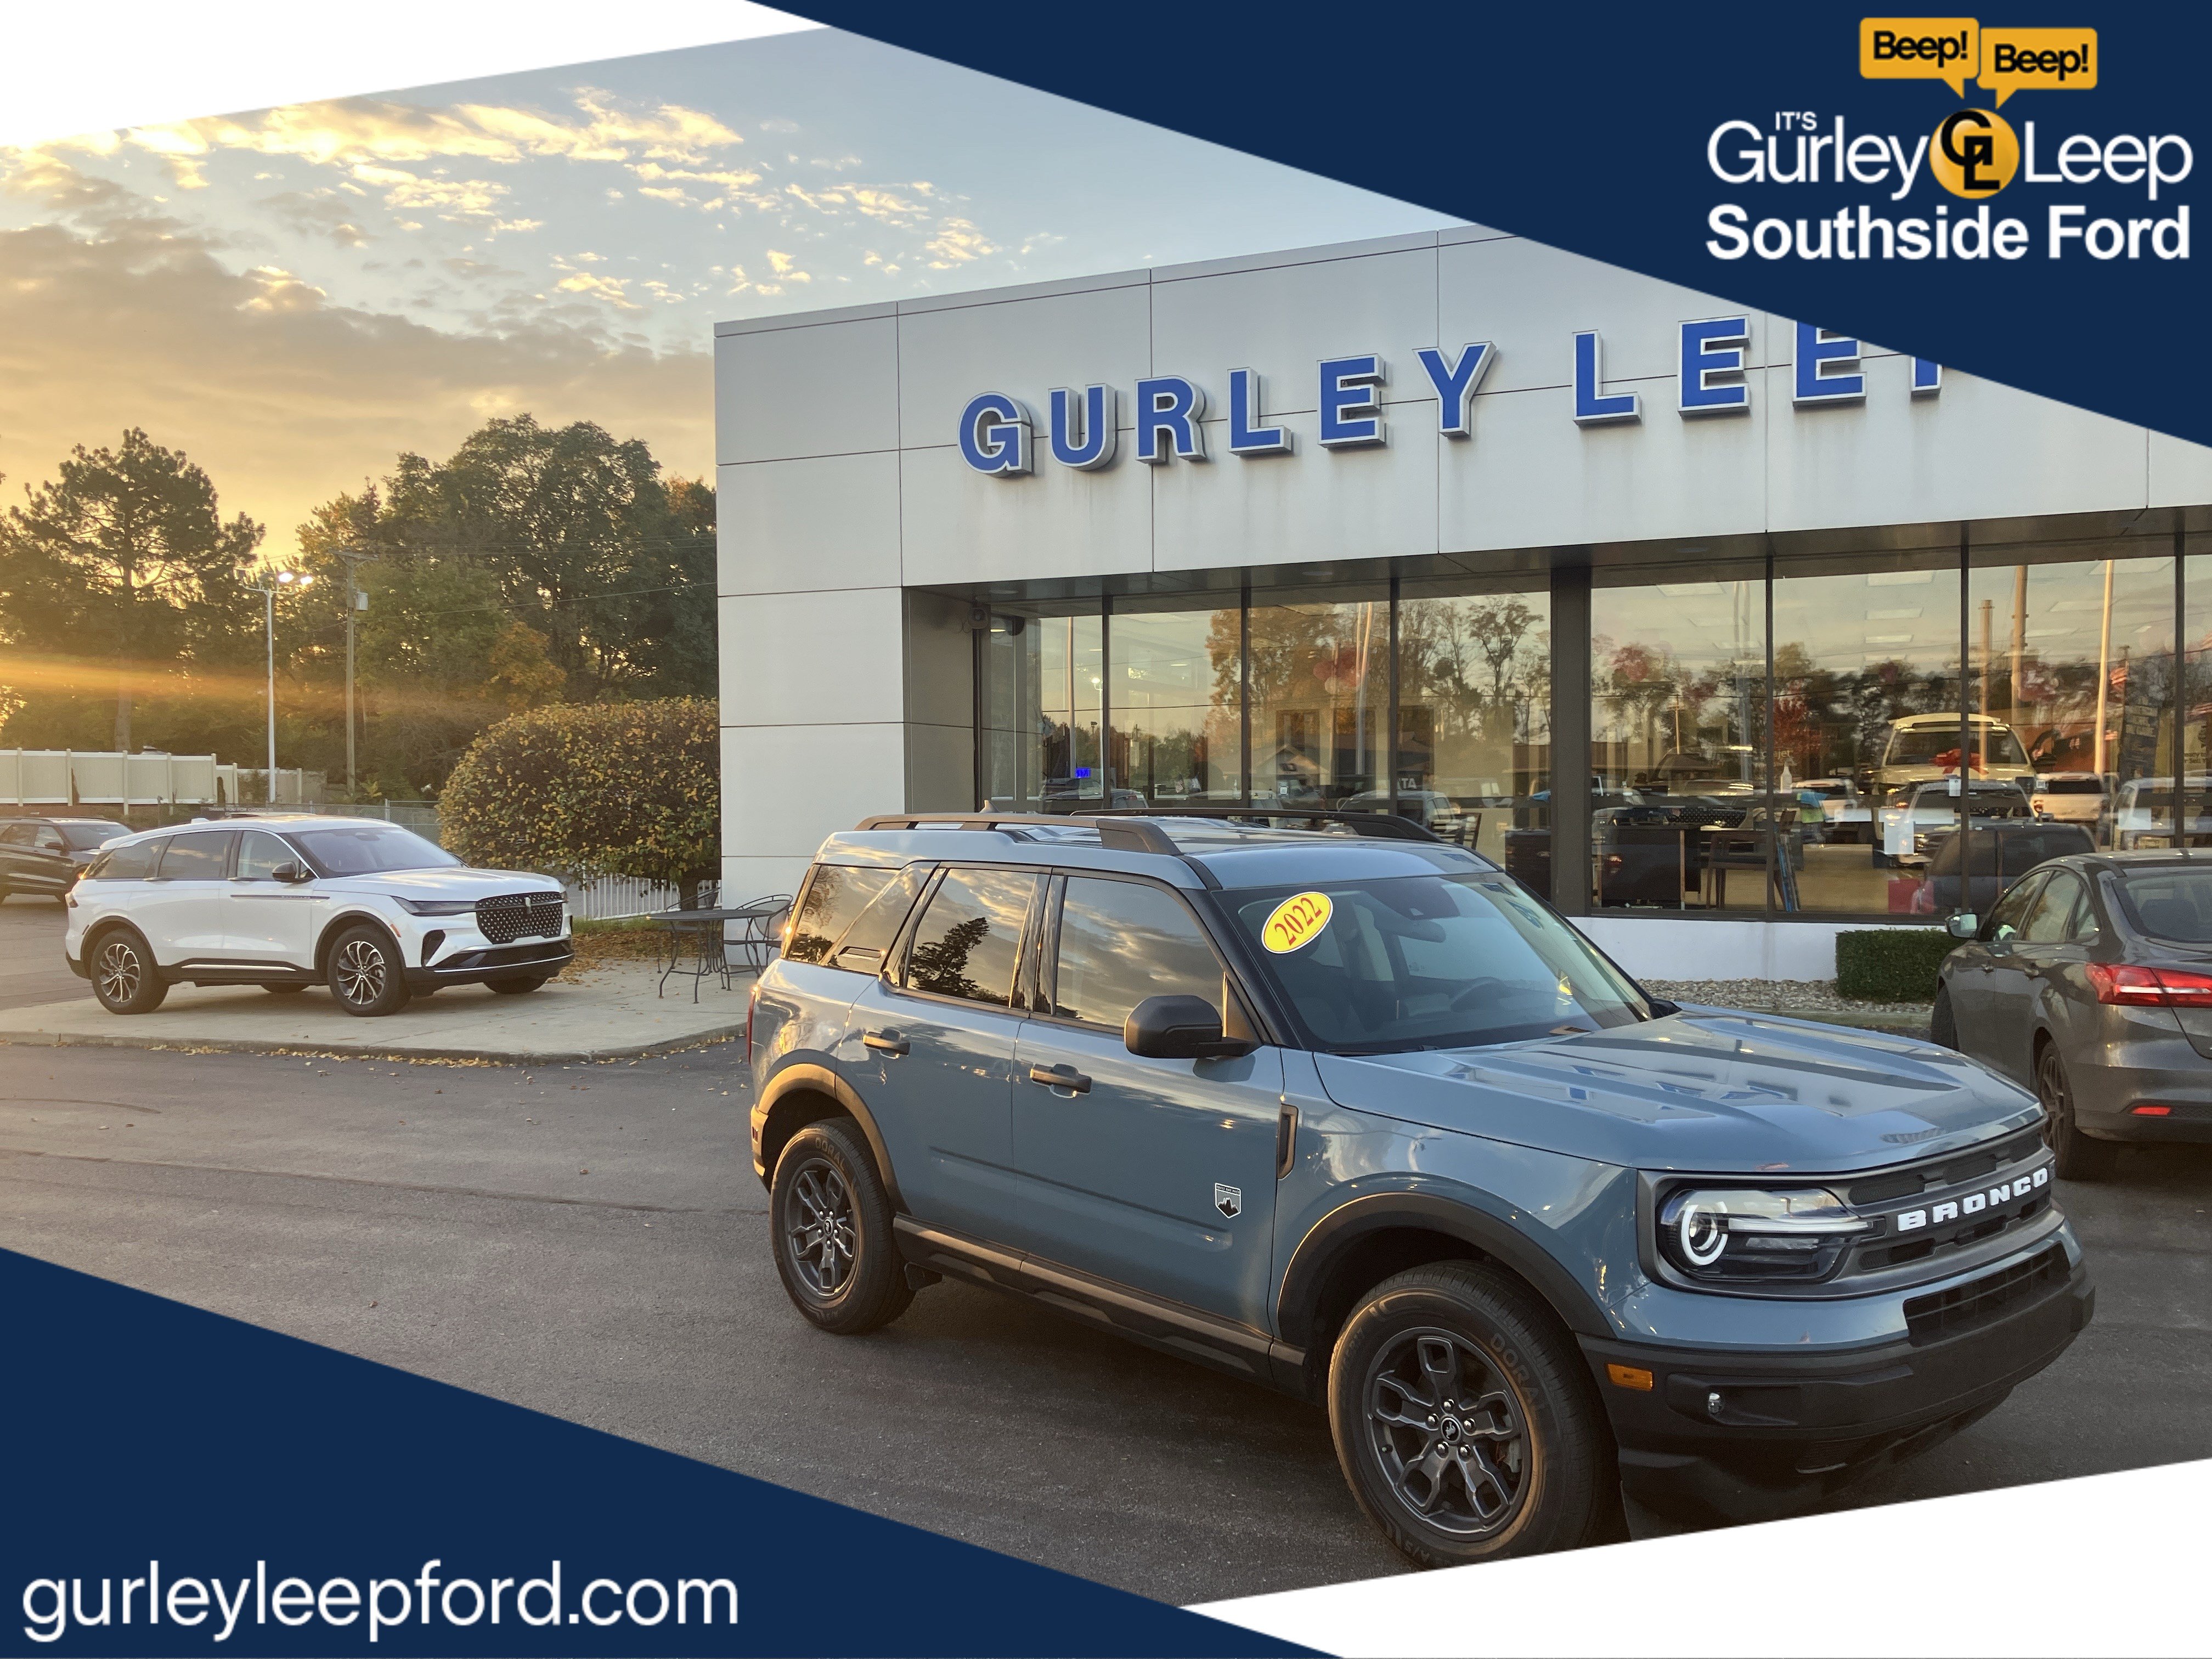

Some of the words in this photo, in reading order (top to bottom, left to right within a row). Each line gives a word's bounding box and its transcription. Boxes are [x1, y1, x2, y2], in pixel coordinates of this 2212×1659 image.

[957, 341, 1497, 476] GURLEY
[1274, 898, 1322, 946] 2022
[1897, 1167, 2049, 1232] BRONCO
